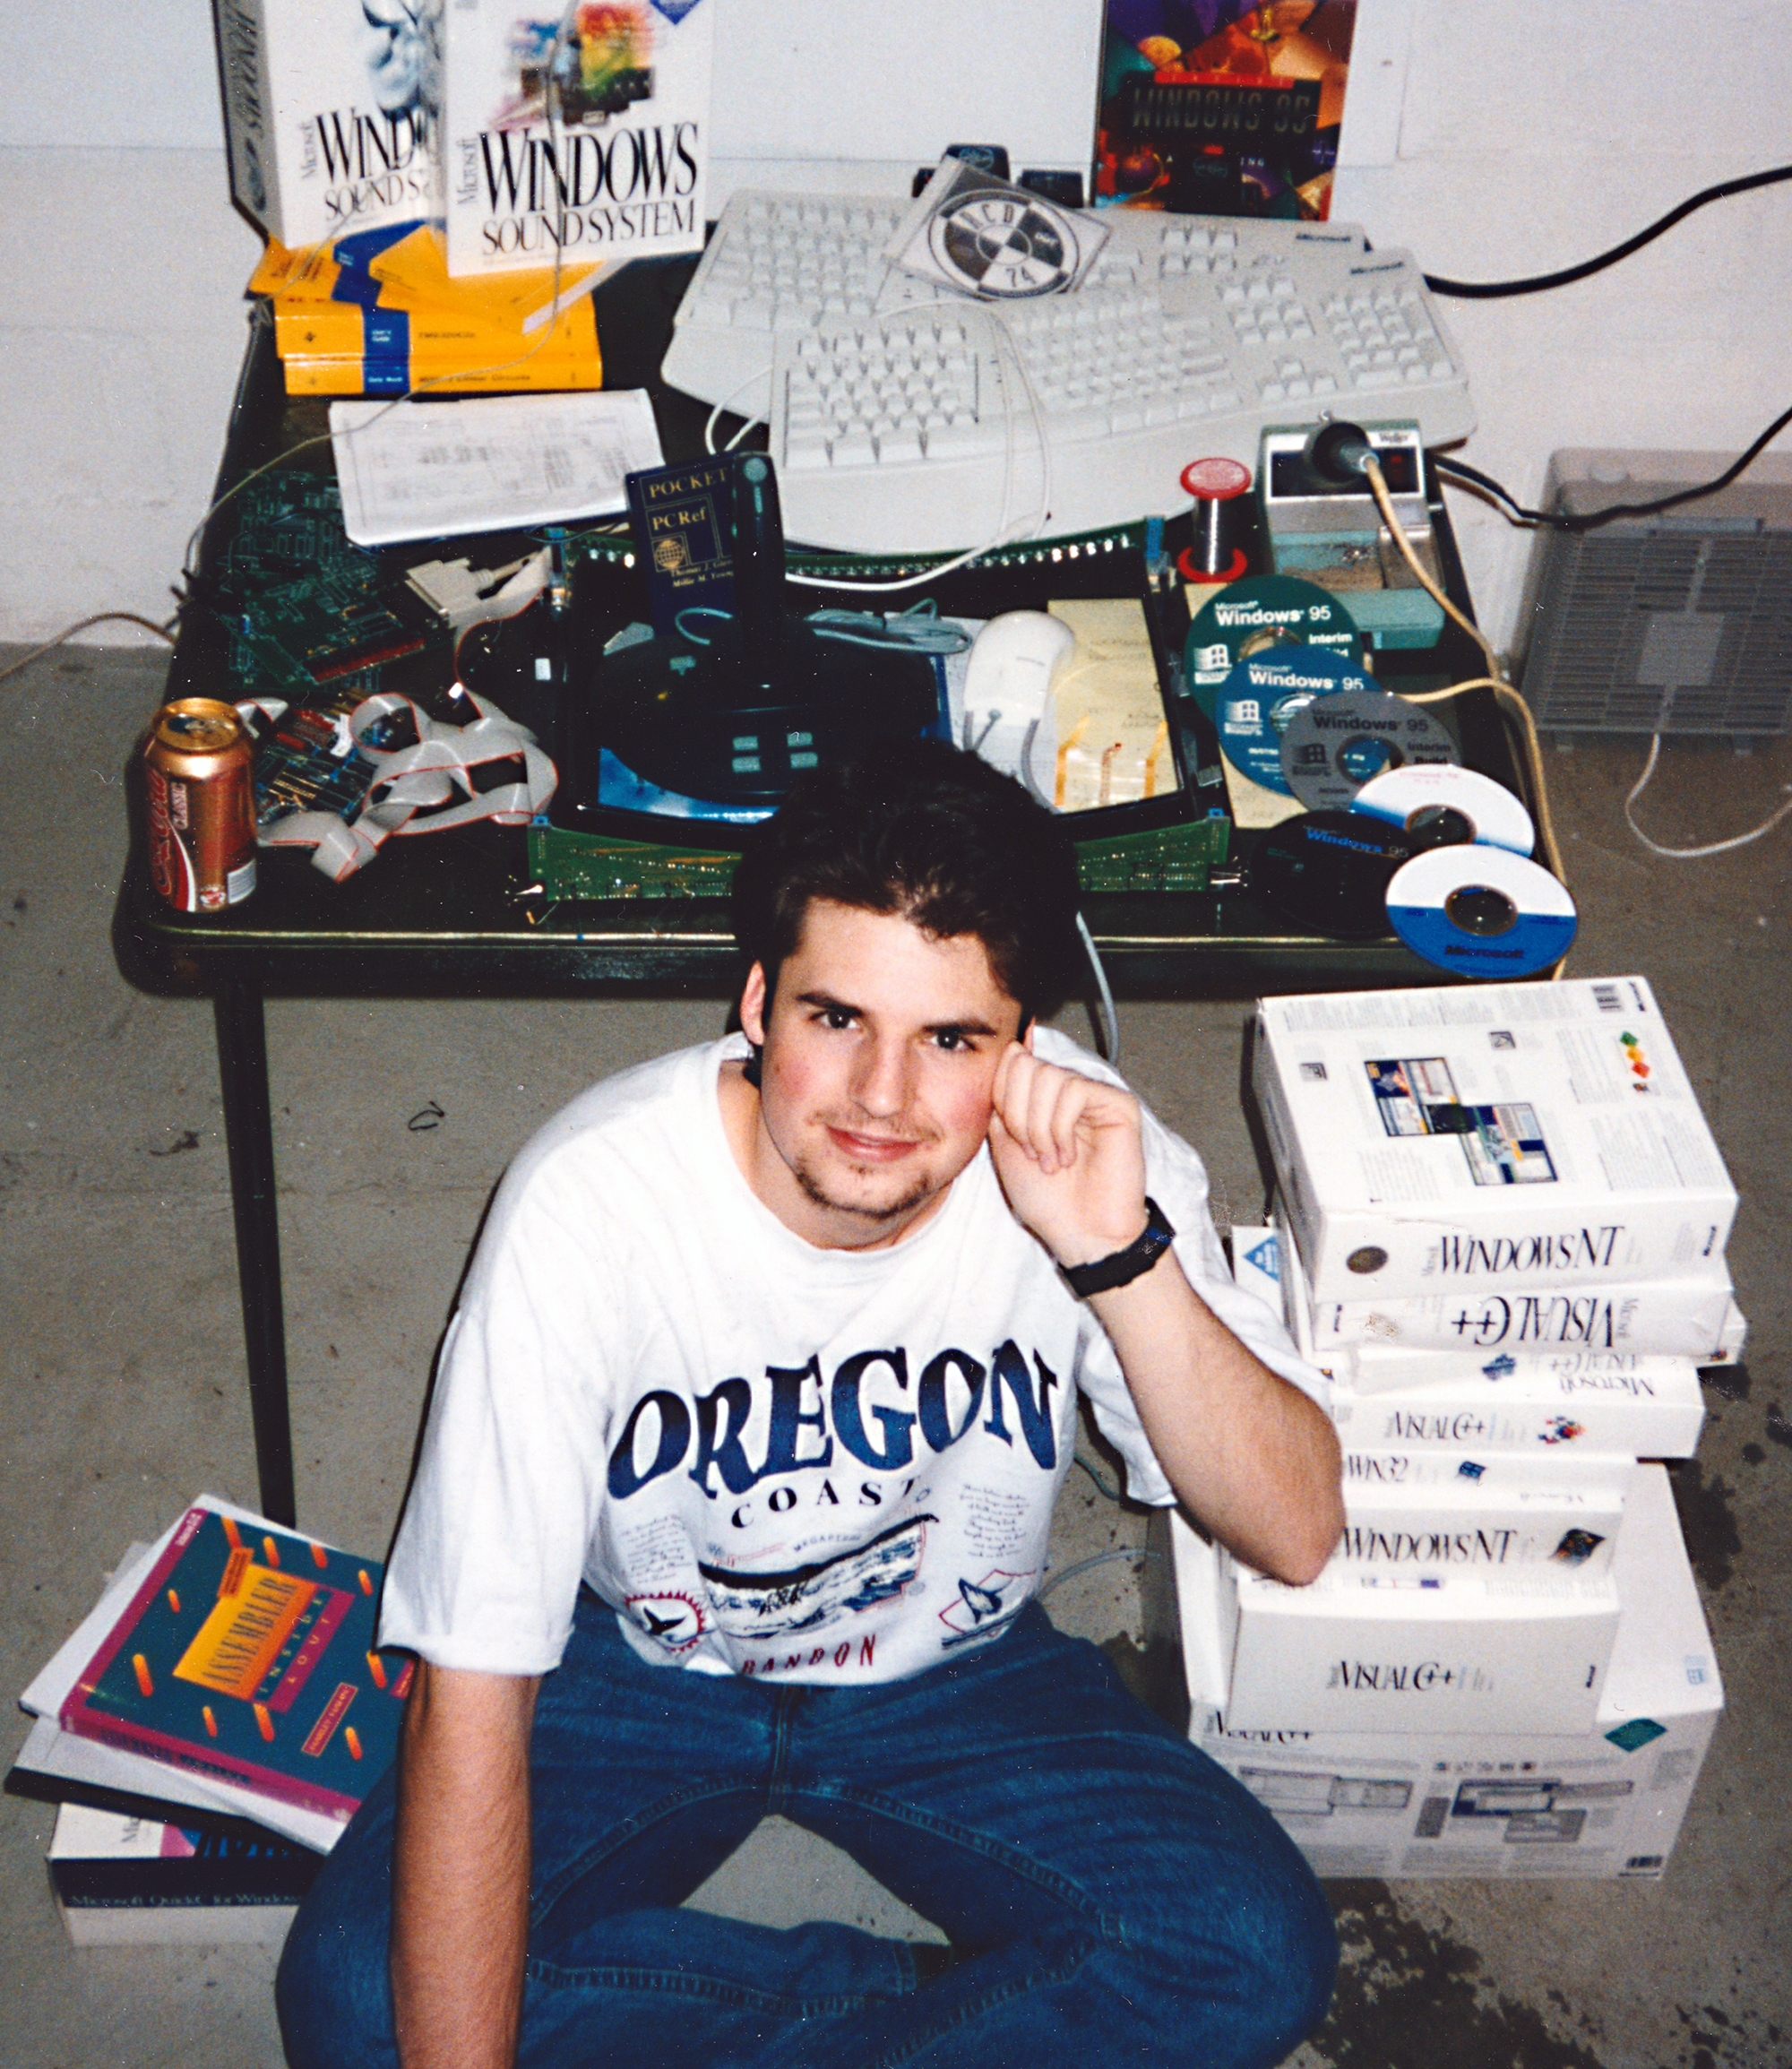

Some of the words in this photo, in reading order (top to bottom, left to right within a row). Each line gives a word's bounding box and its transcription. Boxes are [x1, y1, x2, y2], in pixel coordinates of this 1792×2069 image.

[1133, 88, 1262, 131] WINDOWS
[1273, 92, 1310, 134] 95
[316, 107, 428, 184] WIND
[456, 137, 478, 206] Microsoft
[478, 121, 699, 214] WINDOWS
[325, 174, 403, 220] SOUND
[483, 210, 584, 255] SOUND
[588, 198, 695, 244] SYSTEM
[649, 468, 729, 498] POCKET
[1214, 599, 1259, 611] Microsoft
[1215, 608, 1303, 626] Windows
[1308, 605, 1331, 621] 95
[1308, 632, 1353, 644] Interim
[1248, 670, 1335, 690] Windows
[1341, 677, 1366, 690] 95
[1313, 716, 1399, 731] Windows
[1406, 718, 1429, 732] 95
[1407, 741, 1452, 752] Interim
[171, 781, 188, 829] CLASSIC
[1305, 828, 1383, 853] Windows
[1389, 845, 1409, 858] 95
[1444, 944, 1524, 959] Microsoft
[1441, 1234, 1575, 1275] WINDOWS
[1573, 1225, 1625, 1269] NT
[1452, 1296, 1511, 1346] C++
[1517, 1296, 1614, 1348] VISUAL
[607, 1339, 1059, 1500] OREGON
[1452, 1412, 1486, 1440] C++
[793, 1533, 862, 1552] MEGAPTE
[1344, 1527, 1472, 1563] WINDOWS
[1472, 1528, 1518, 1563] NT
[202, 1577, 299, 1688] ASSEMBLER
[258, 1598, 323, 1694] INSIDE
[297, 1617, 331, 1666] OUT
[1340, 1660, 1409, 1691] VISUAL
[1413, 1660, 1455, 1692] C++
[71, 1894, 143, 1906] Microsoft
